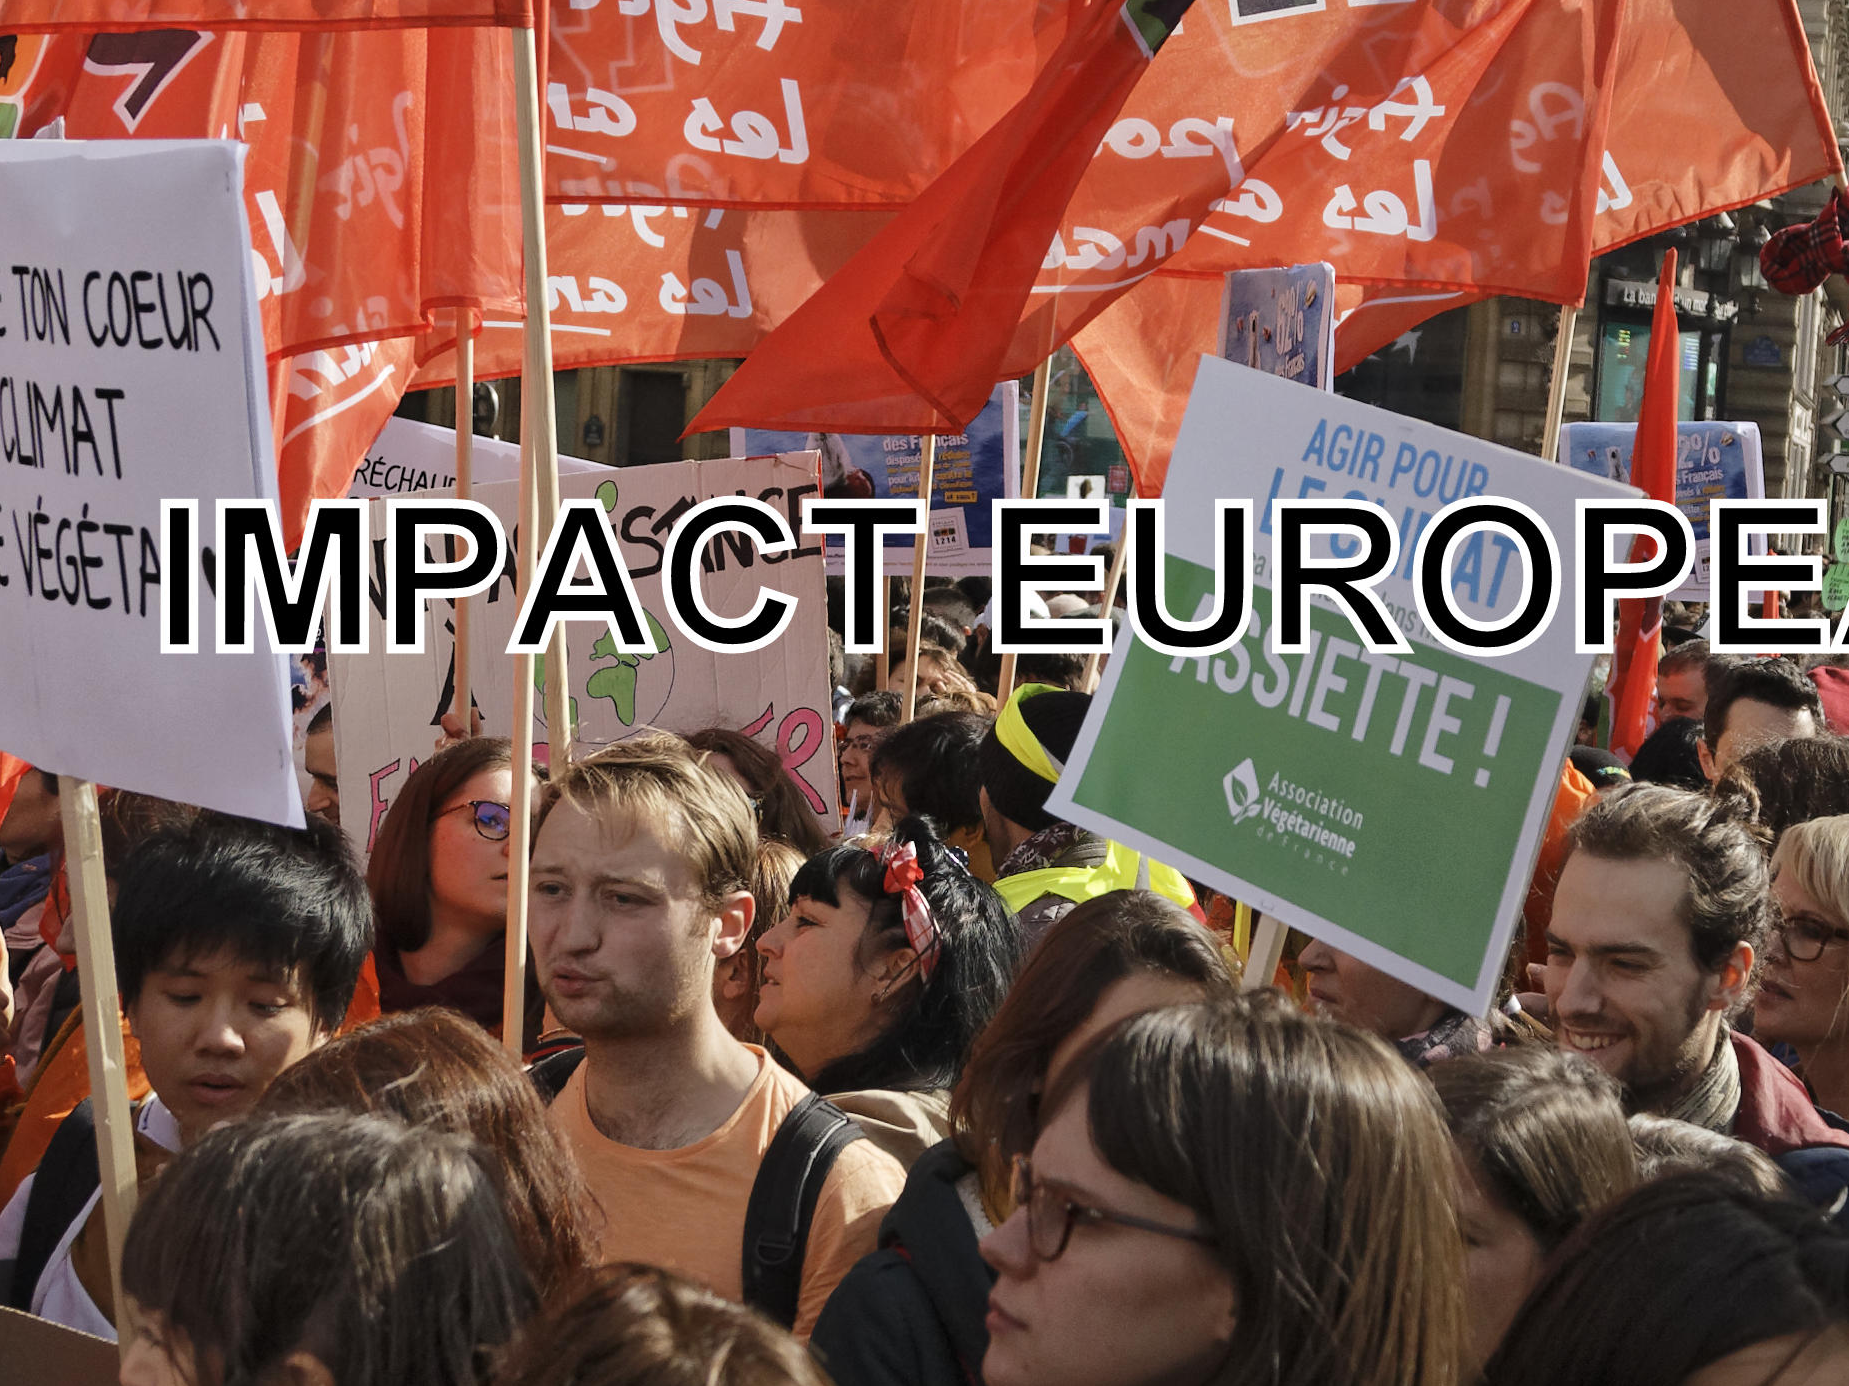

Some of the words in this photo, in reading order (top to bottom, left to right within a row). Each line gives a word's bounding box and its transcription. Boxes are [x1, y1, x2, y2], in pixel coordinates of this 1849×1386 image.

[12, 264, 71, 346] TON
[82, 269, 222, 352] COEUR
[0, 375, 125, 481] CLIMAT
[1302, 418, 1386, 484] AGIR
[1388, 441, 1490, 505] POUR
[1677, 430, 1721, 471] 2%
[12, 494, 161, 618] VÉGÉTA
[1262, 796, 1357, 859] Végétarienne
[1267, 771, 1364, 830] Association
